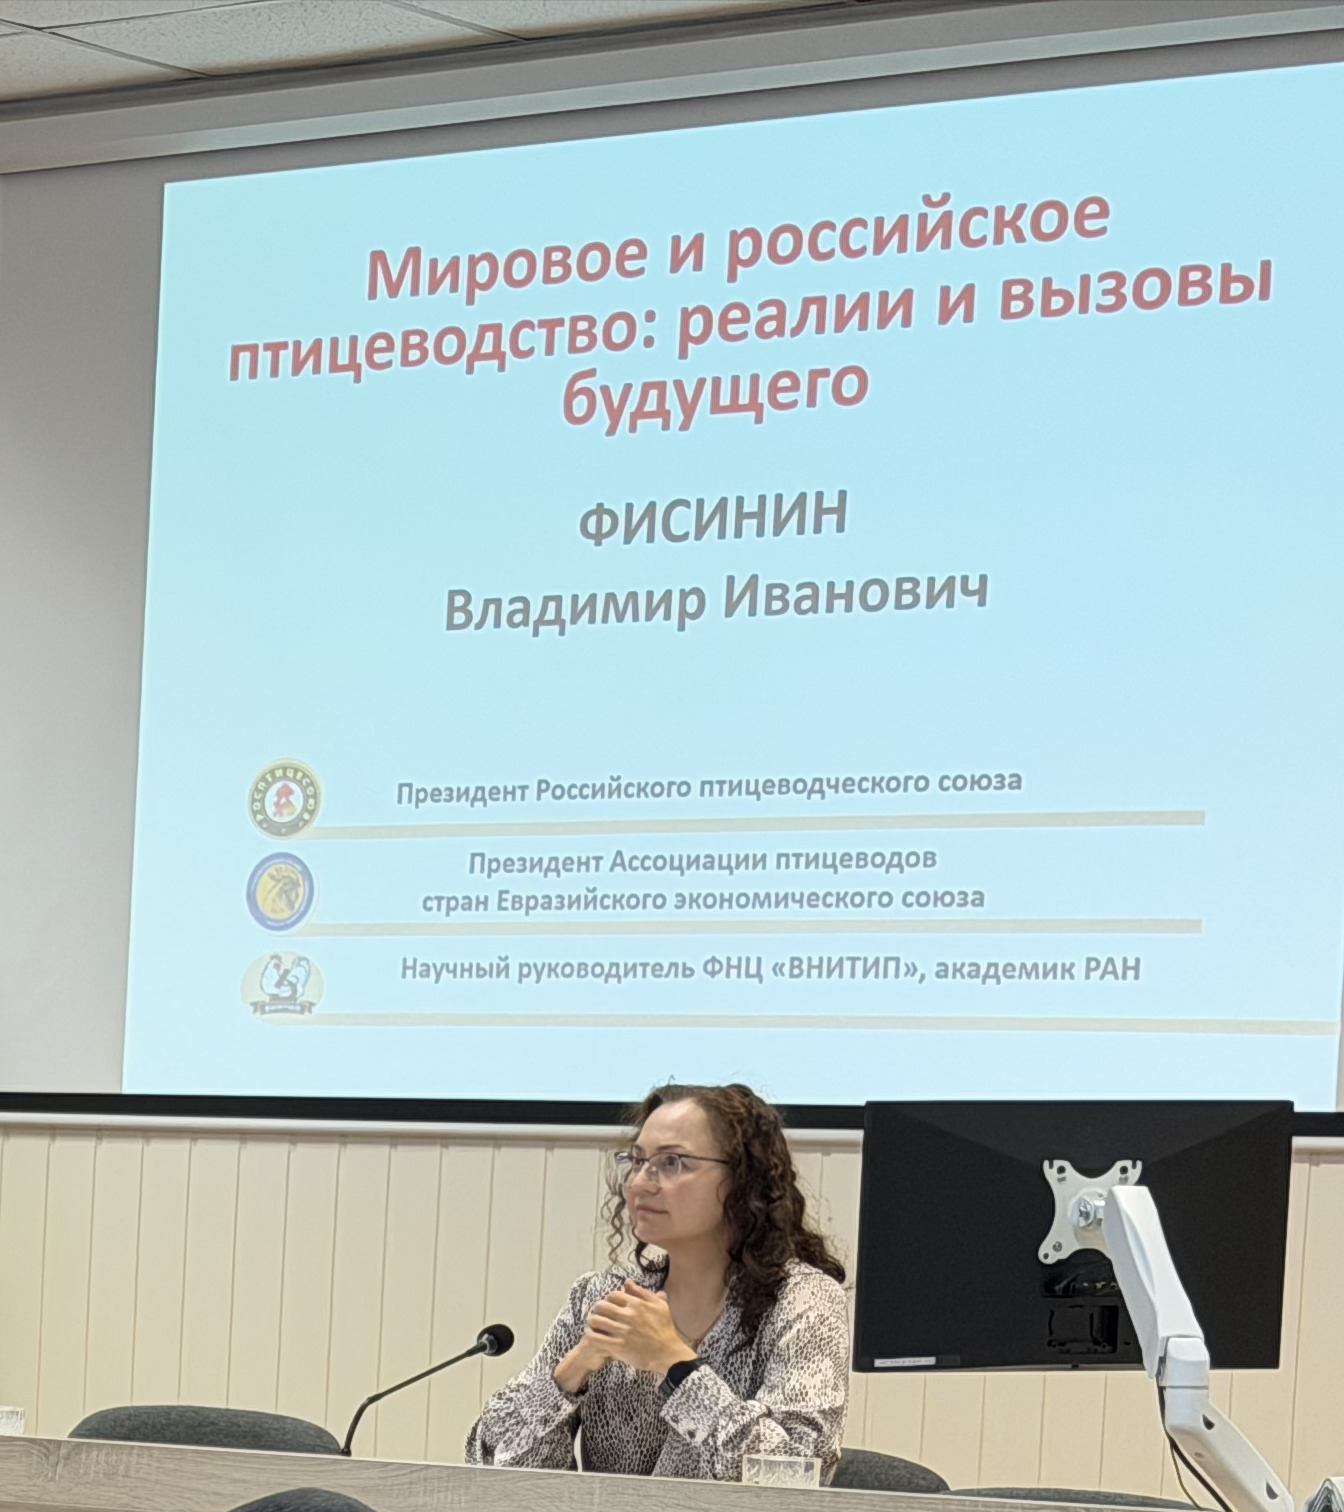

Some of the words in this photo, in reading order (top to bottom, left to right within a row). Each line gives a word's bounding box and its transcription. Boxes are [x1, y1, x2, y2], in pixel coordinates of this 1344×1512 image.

[367, 237, 648, 307] Мировое
[669, 232, 705, 275] и
[726, 191, 1111, 284] российское
[229, 309, 657, 385] птицеводство:
[677, 287, 915, 361] реалии
[937, 282, 976, 326] и
[1000, 258, 1272, 321] вызовы
[563, 364, 869, 438] будущего
[579, 489, 848, 547] ФИСИНИН
[445, 586, 707, 638] Владимир
[724, 573, 989, 619] Иванович
[396, 781, 530, 810] Президент
[535, 774, 693, 802] Российского
[698, 774, 931, 802] птицеводческого
[937, 772, 1023, 793] союза
[468, 851, 605, 880] Президент
[608, 849, 768, 878] Ассоциации
[775, 850, 938, 876] птицеводов
[421, 894, 490, 918] стран
[496, 885, 668, 917] Евразийского
[673, 890, 895, 911] экономического
[901, 889, 986, 909] союза
[400, 954, 511, 985] Научный
[516, 960, 696, 985] руководитель
[702, 955, 764, 985] ФНЦ
[771, 955, 927, 985] «ВНИТИП»,
[934, 961, 1077, 986] академик
[1084, 955, 1142, 982] РАН
